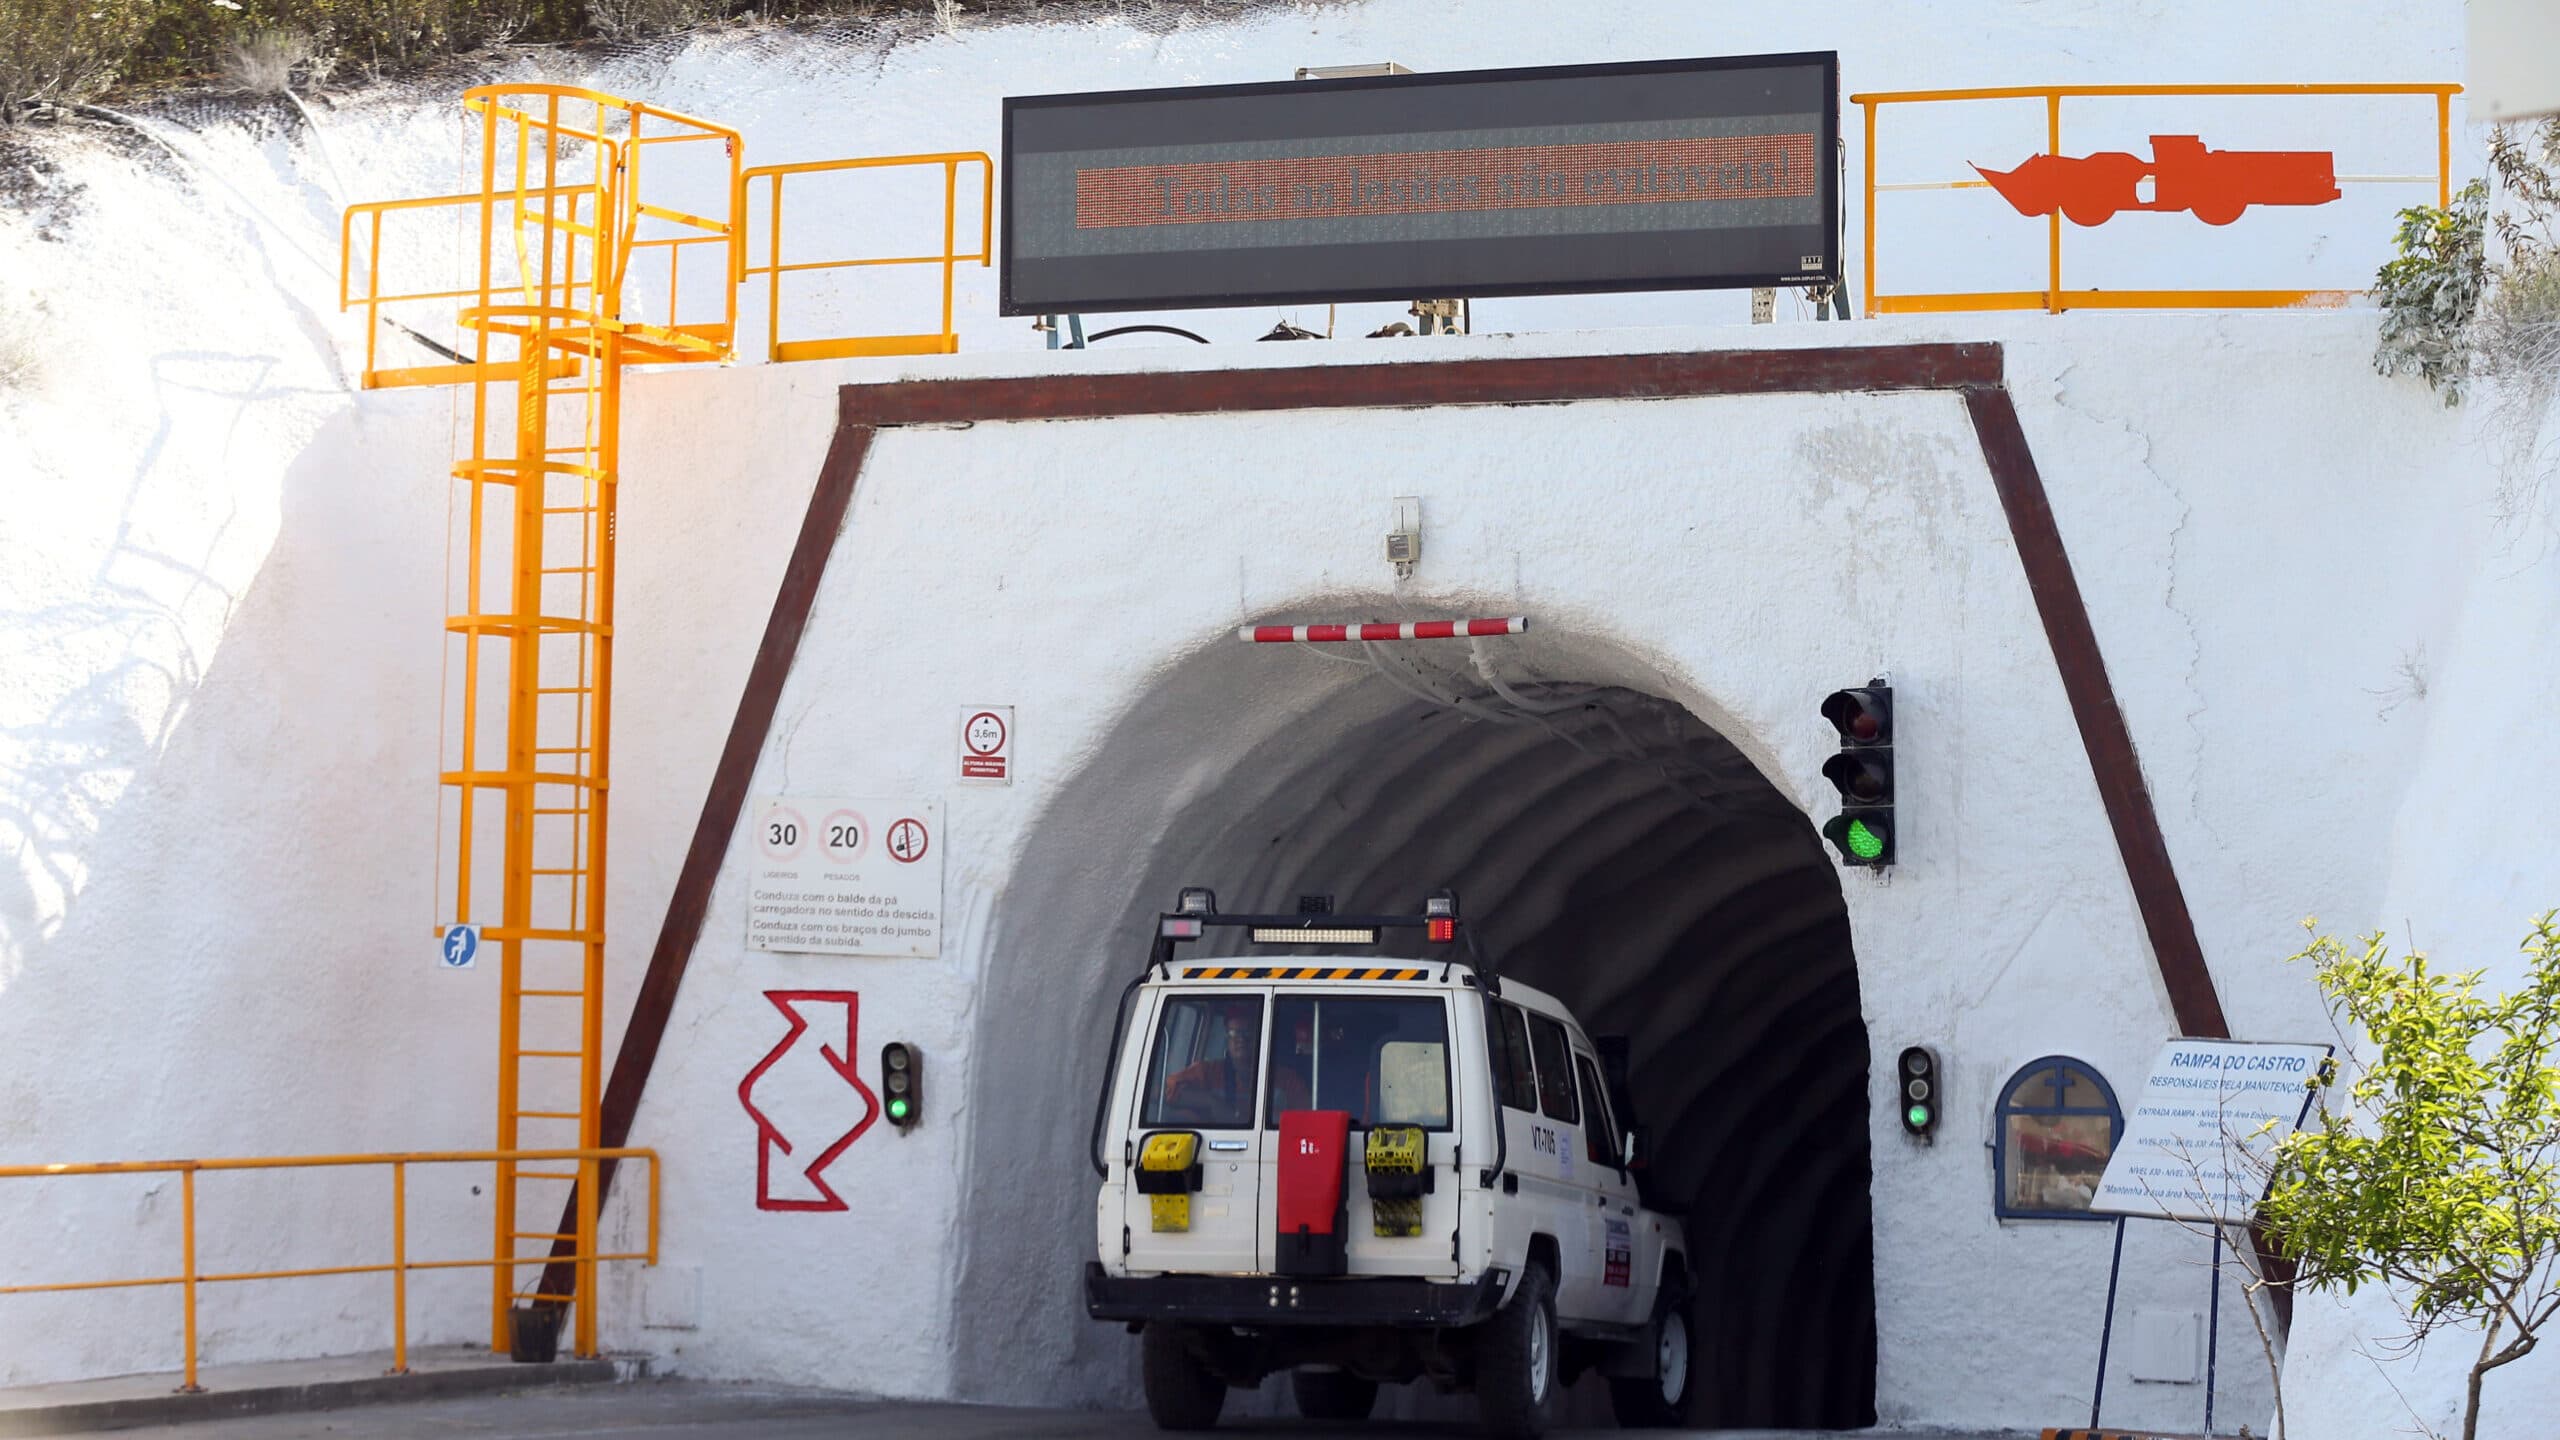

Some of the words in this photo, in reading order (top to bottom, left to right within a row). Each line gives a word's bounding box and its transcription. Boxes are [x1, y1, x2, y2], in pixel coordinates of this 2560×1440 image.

[1155, 173, 1275, 216] Todas
[1294, 182, 1334, 209] as
[1350, 166, 1480, 207] lesões
[1500, 162, 1566, 199] são
[1584, 150, 1790, 196] evitáveis!
[974, 729, 998, 739] 3,6m
[769, 823, 797, 846] 30
[830, 825, 858, 848] 20
[823, 873, 860, 881] PESADOS
[754, 889, 799, 901] Conduza
[802, 893, 825, 902] com
[828, 894, 835, 903] o
[837, 892, 866, 904] balde
[868, 894, 882, 905] da
[885, 895, 898, 907] pá
[754, 905, 815, 917] carregadora
[819, 908, 832, 916] no
[835, 906, 874, 919] sentido
[877, 909, 890, 919] da
[892, 909, 936, 920] descida.
[753, 919, 798, 931] Conduza
[801, 923, 824, 932] com
[826, 924, 839, 932] os
[842, 923, 877, 936] braços
[880, 925, 894, 935] do
[896, 925, 931, 938] jumbo
[768, 933, 806, 944] sentido
[809, 935, 822, 945] da
[825, 935, 862, 947] subida.
[2171, 1053, 2220, 1069] RAMPA
[2223, 1055, 2246, 1070] DO
[2247, 1056, 2306, 1072] CASTRO
[2149, 1075, 2219, 1090] RESPONSÁVEIS
[2219, 1079, 2247, 1092] PELA
[2138, 1107, 2171, 1116] ENTRADA
[2171, 1109, 2196, 1117] RAMPA
[1531, 1124, 1556, 1155] VT-705
